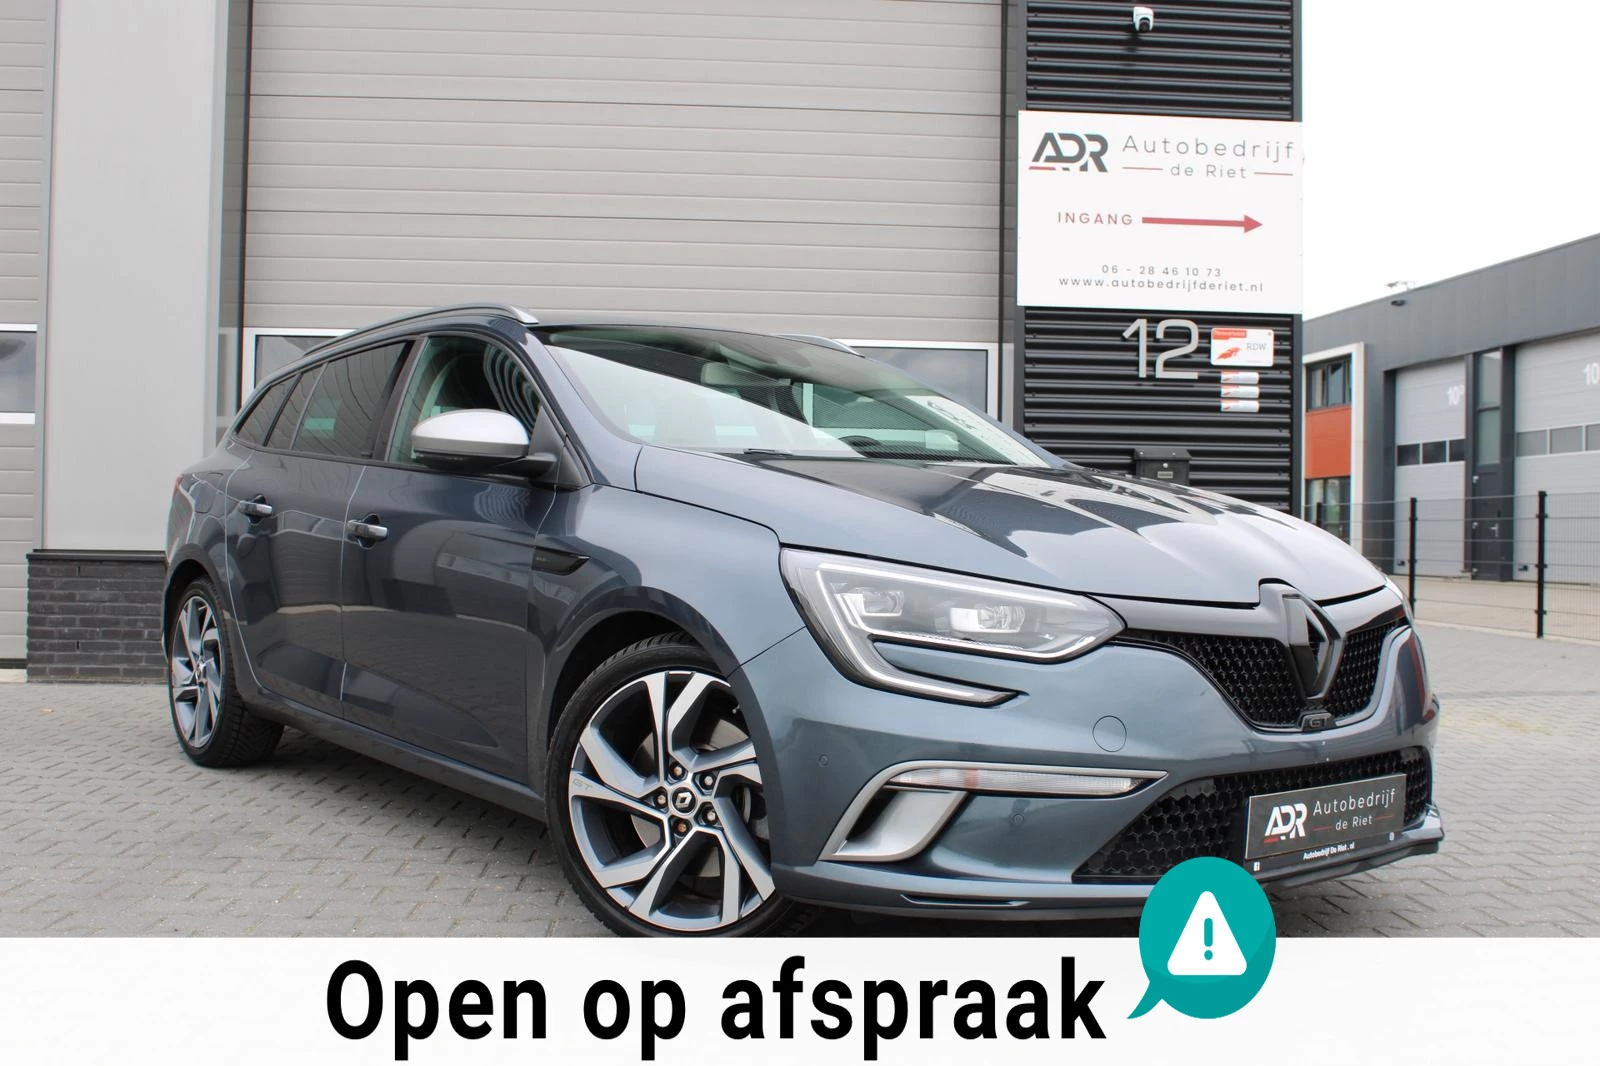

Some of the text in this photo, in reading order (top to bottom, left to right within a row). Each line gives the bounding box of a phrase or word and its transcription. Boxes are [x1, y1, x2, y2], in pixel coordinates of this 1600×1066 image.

[1029, 132, 1108, 172] ADR
[1121, 135, 1294, 163] Autobedrijf
[1170, 163, 1246, 178] de Riet
[1057, 211, 1133, 226] INGANG
[1101, 264, 1119, 275] 06
[1138, 265, 1156, 276] 28
[1161, 266, 1179, 277] 46
[1185, 266, 1200, 277] 10
[1206, 267, 1222, 278] 73
[1122, 318, 1199, 380] 12
[1246, 342, 1268, 352] RDW
[1310, 717, 1329, 728] GT
[1312, 788, 1396, 817] Autobedrijf
[1264, 803, 1308, 840] ADR
[1335, 815, 1373, 831] de Riet
